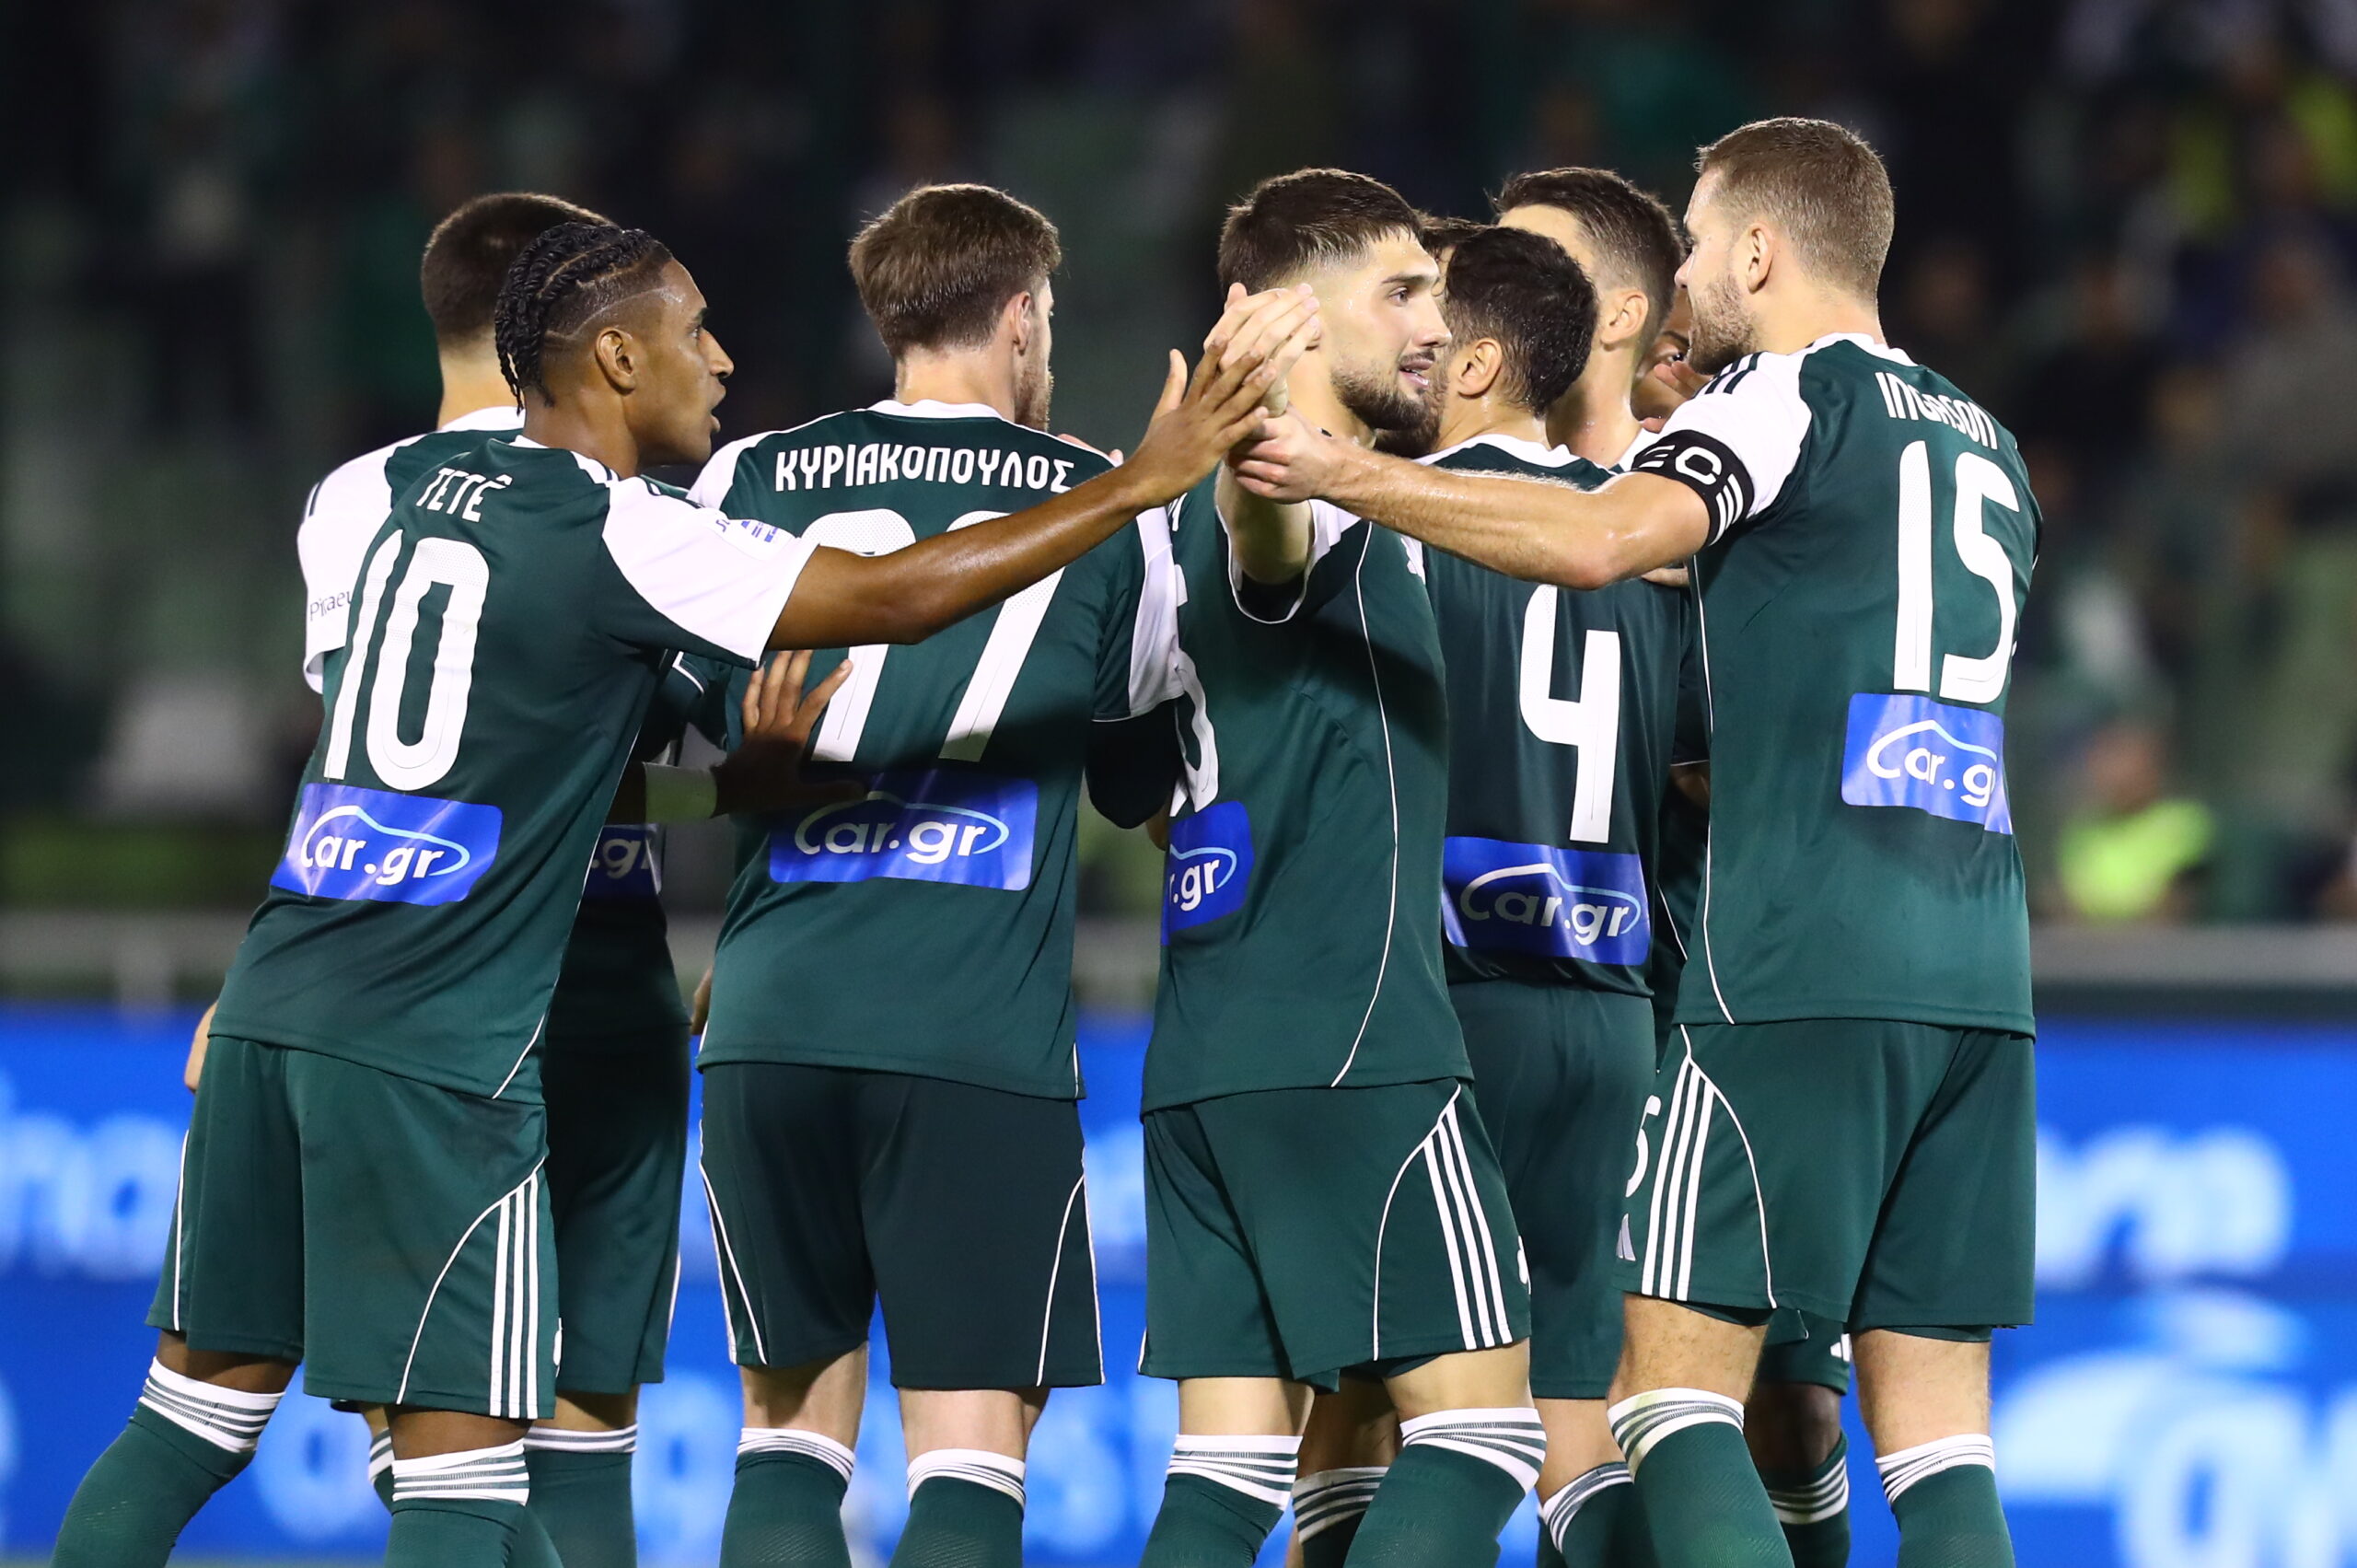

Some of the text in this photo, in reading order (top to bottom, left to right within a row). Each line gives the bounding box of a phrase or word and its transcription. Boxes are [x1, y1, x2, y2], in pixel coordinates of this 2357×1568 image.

[1875, 372, 1998, 450] INGASON
[415, 467, 514, 523] TETÊ
[775, 443, 1075, 494] ΚΥΡΙΑΚΟΠΟΥΛΟΣ
[1893, 440, 2018, 704] 15
[324, 528, 490, 791] 10
[1519, 585, 1620, 843] 4
[1169, 859, 1220, 912] .gr
